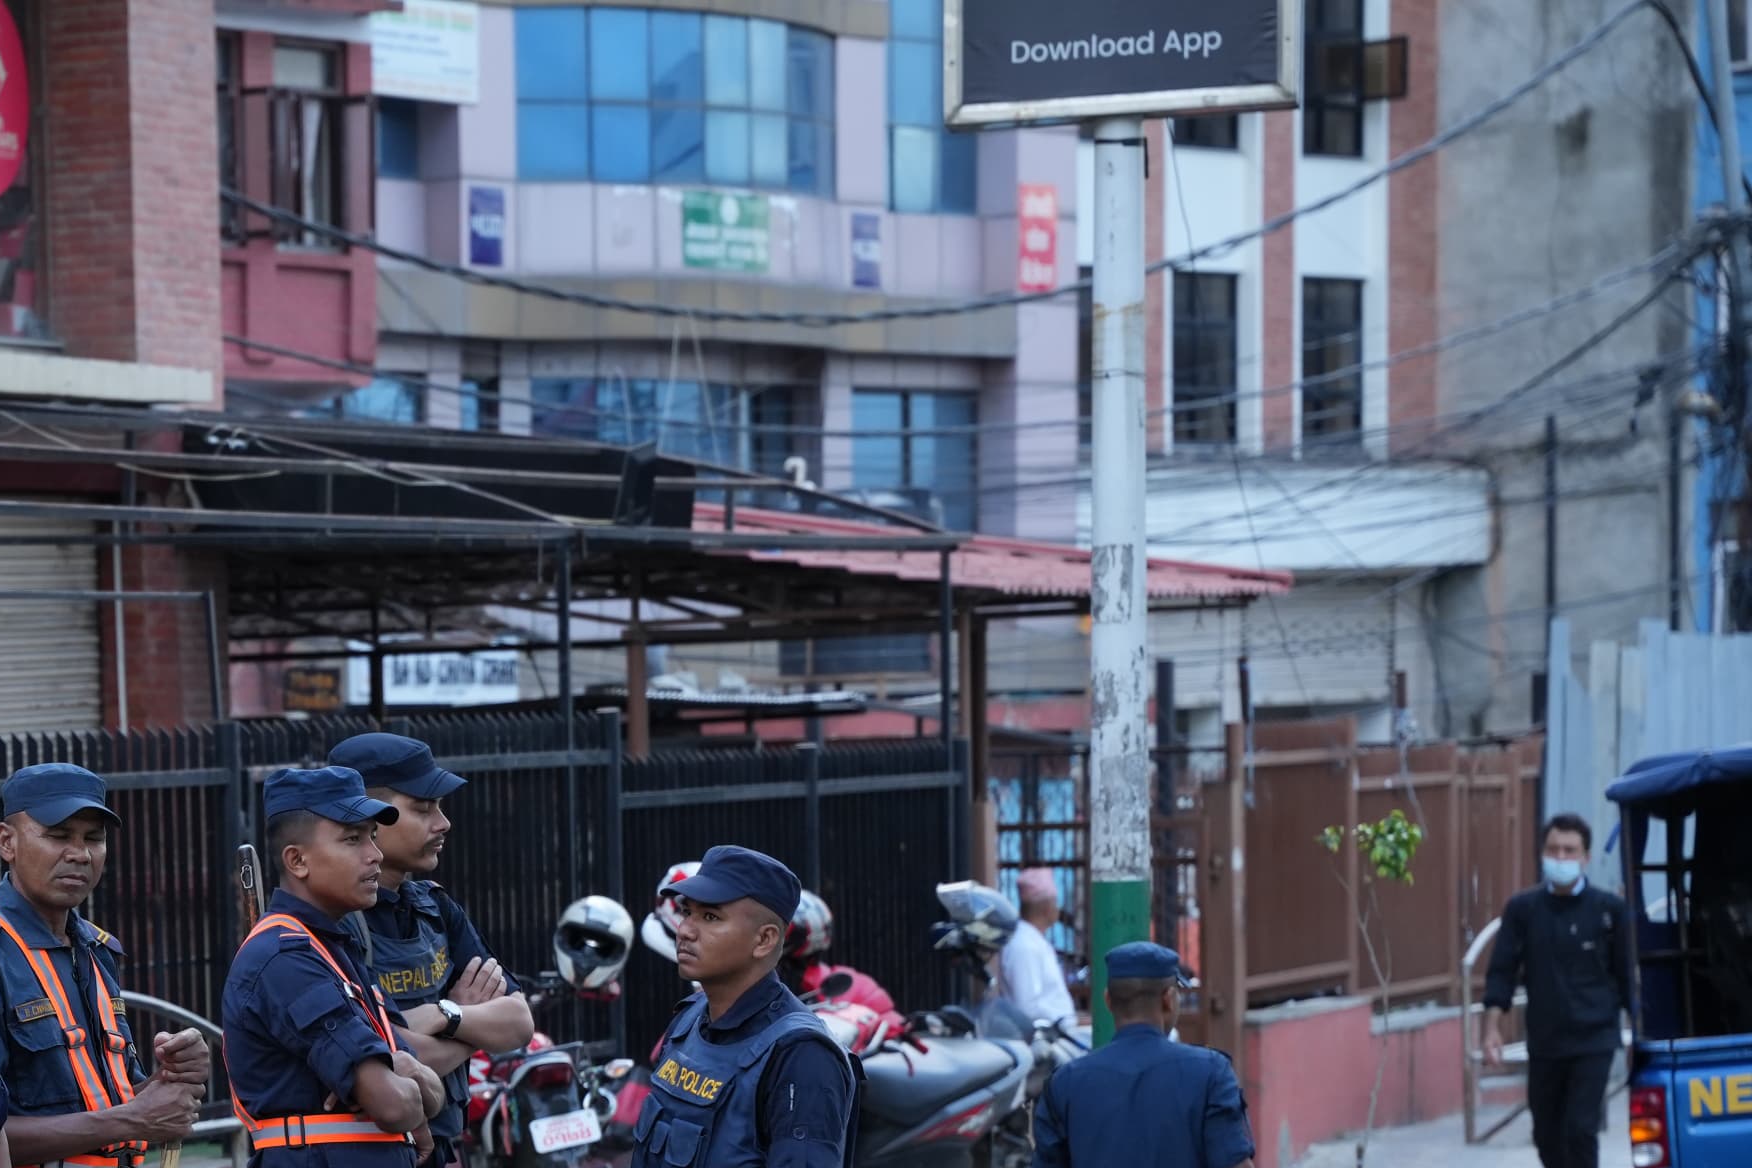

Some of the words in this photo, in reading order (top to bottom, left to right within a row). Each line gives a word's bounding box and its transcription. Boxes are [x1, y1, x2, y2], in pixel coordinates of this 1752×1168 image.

[1011, 33, 1155, 64] Download
[1163, 29, 1223, 60] App
[378, 964, 431, 995] NEPAL
[677, 1066, 724, 1100] POLICE
[1690, 1074, 1752, 1117] NE
